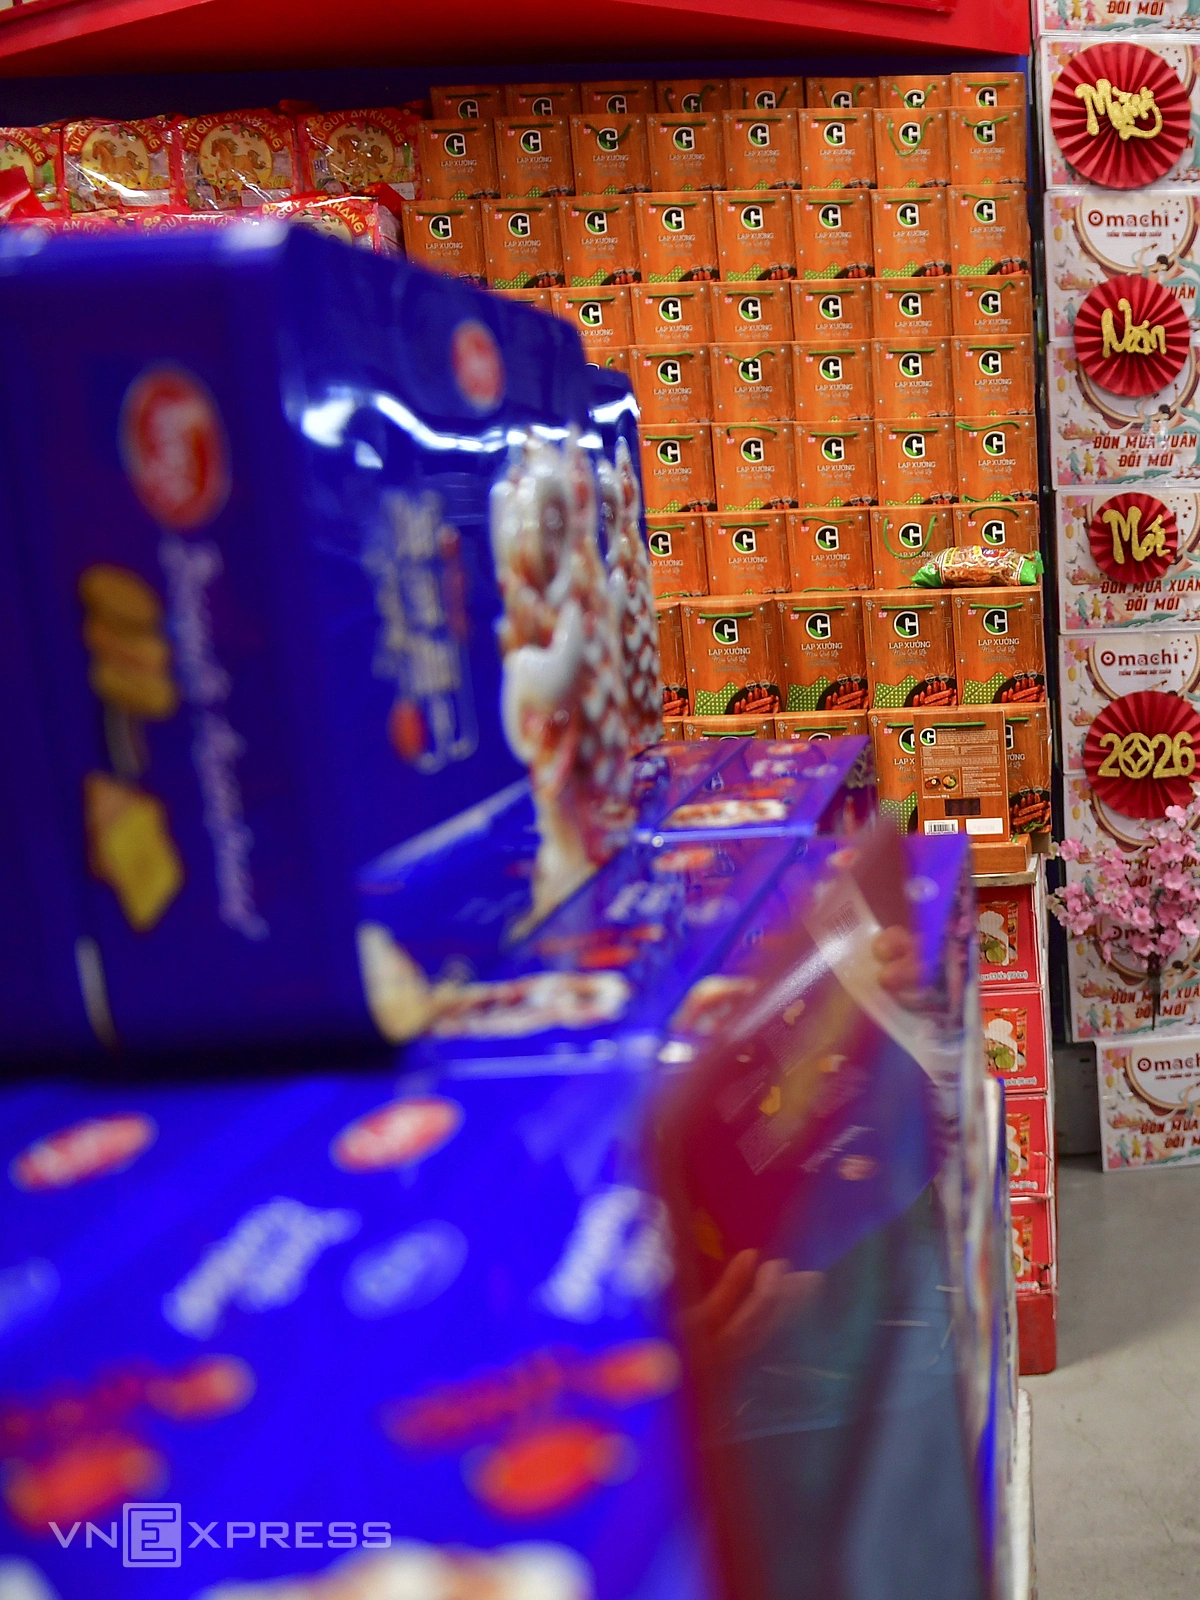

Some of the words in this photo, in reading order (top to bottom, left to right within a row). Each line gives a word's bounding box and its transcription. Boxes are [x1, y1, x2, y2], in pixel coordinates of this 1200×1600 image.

[369, 109, 405, 144] KHANG
[1087, 209, 1169, 227] Omachi
[1100, 648, 1179, 667] Omachi
[1097, 731, 1197, 780] 2026
